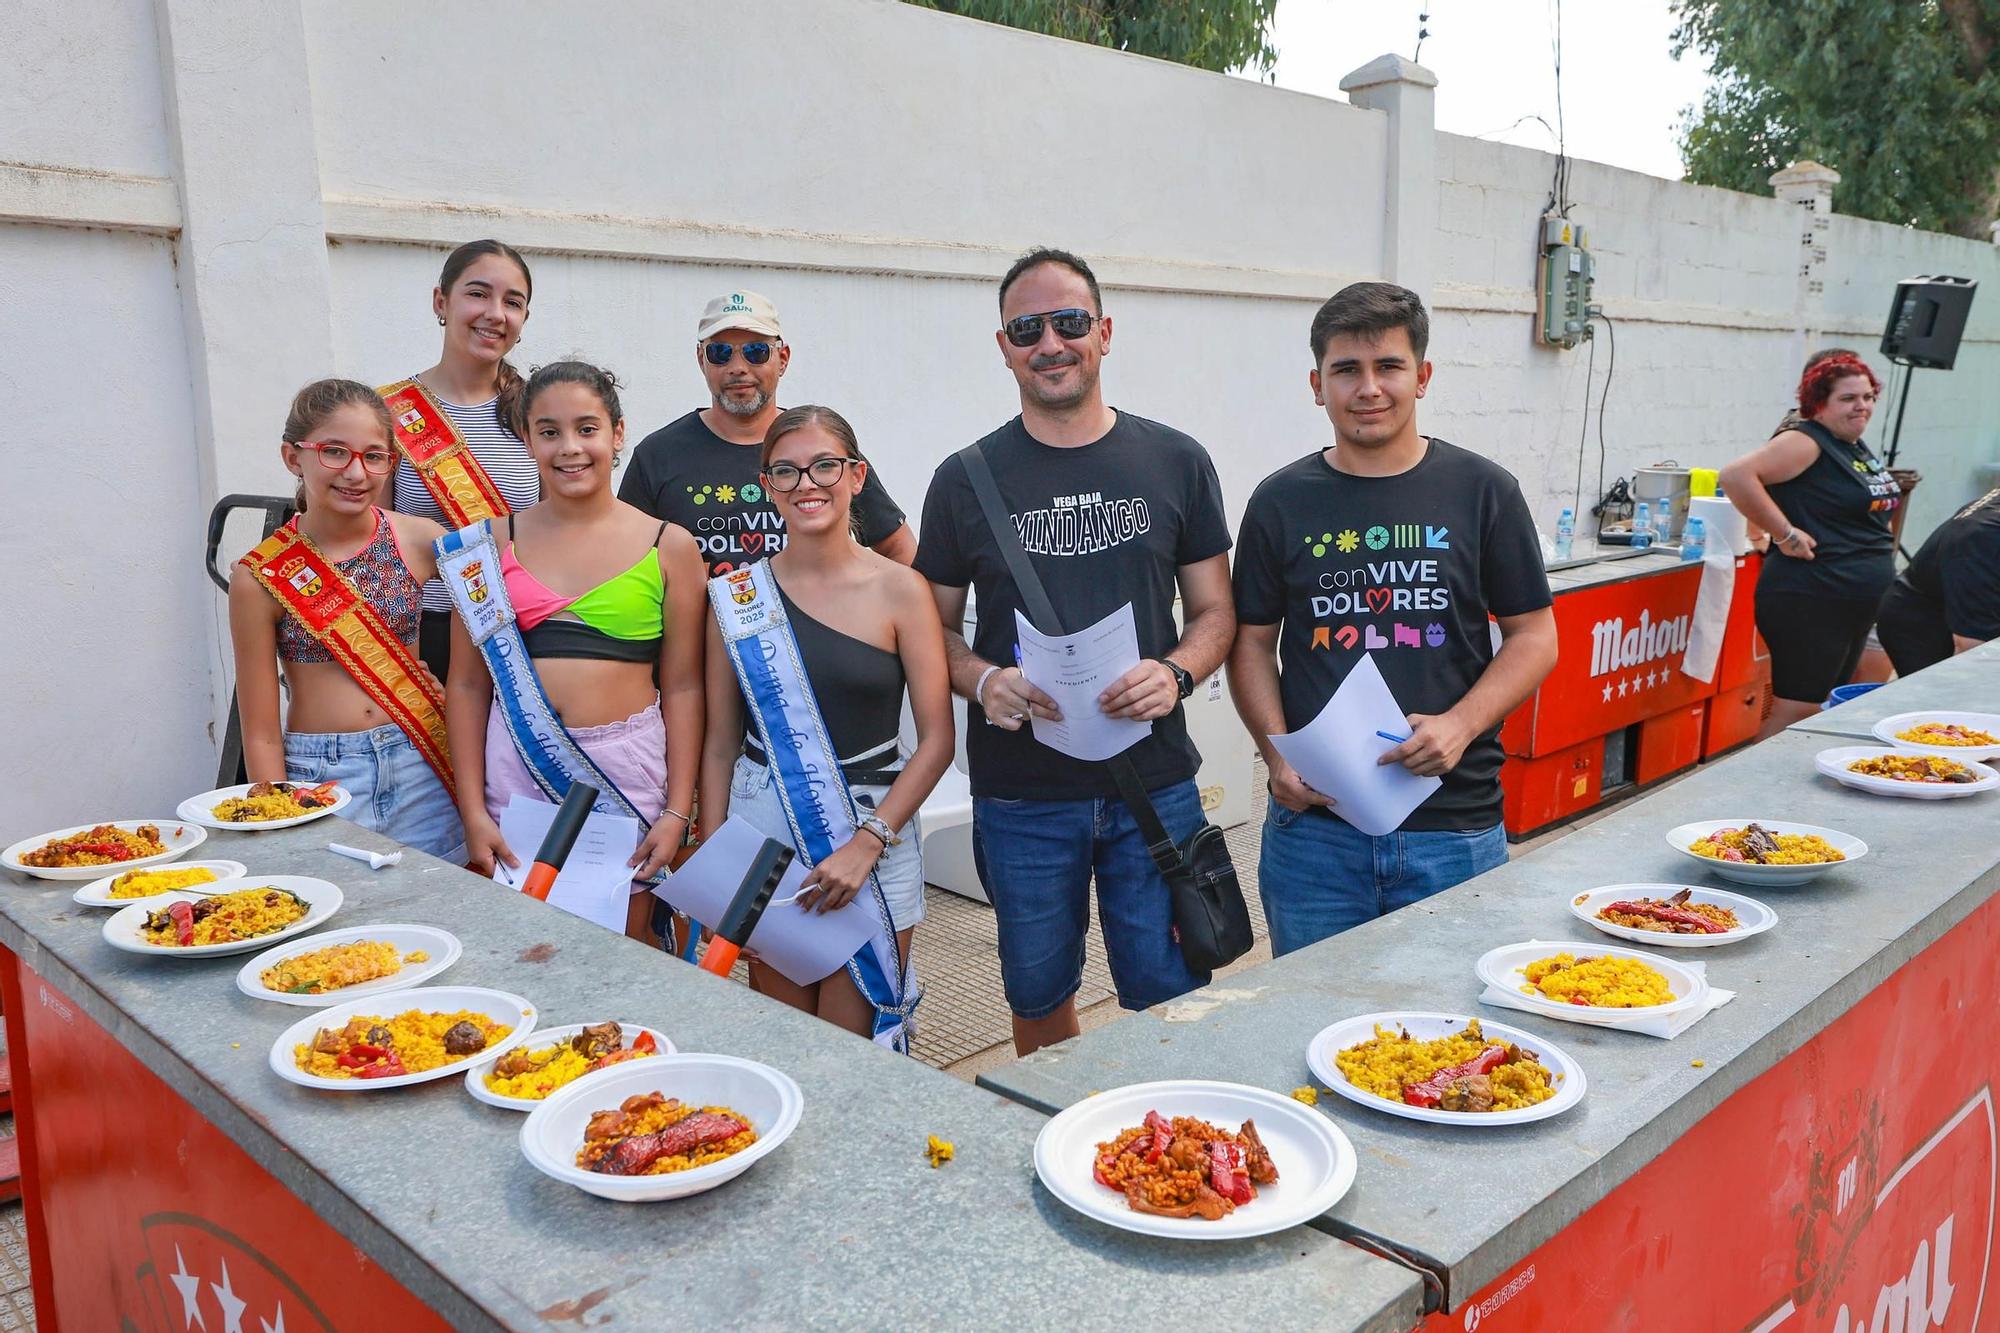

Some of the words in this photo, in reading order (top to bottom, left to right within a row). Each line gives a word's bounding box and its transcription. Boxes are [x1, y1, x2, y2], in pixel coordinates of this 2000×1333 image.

[420, 435, 442, 452] 2025
[1053, 495, 1078, 508] VEGA
[1079, 491, 1102, 505] BAJA
[697, 511, 785, 531] conVIV
[1010, 497, 1151, 556] MINDANGO
[1319, 560, 1438, 590] conVIVE
[320, 595, 344, 617] 2025
[473, 599, 495, 617] DOLORES
[734, 601, 765, 616] DOLORES
[479, 610, 496, 627] 2025
[740, 611, 765, 625] 2025
[346, 624, 401, 683] Reina
[1590, 608, 1689, 678] Mahou
[752, 639, 790, 710] Dama
[493, 636, 522, 700] Dama
[518, 710, 537, 728] de
[530, 732, 574, 782] Hono
[781, 727, 808, 750] de
[793, 763, 836, 840] Honor
